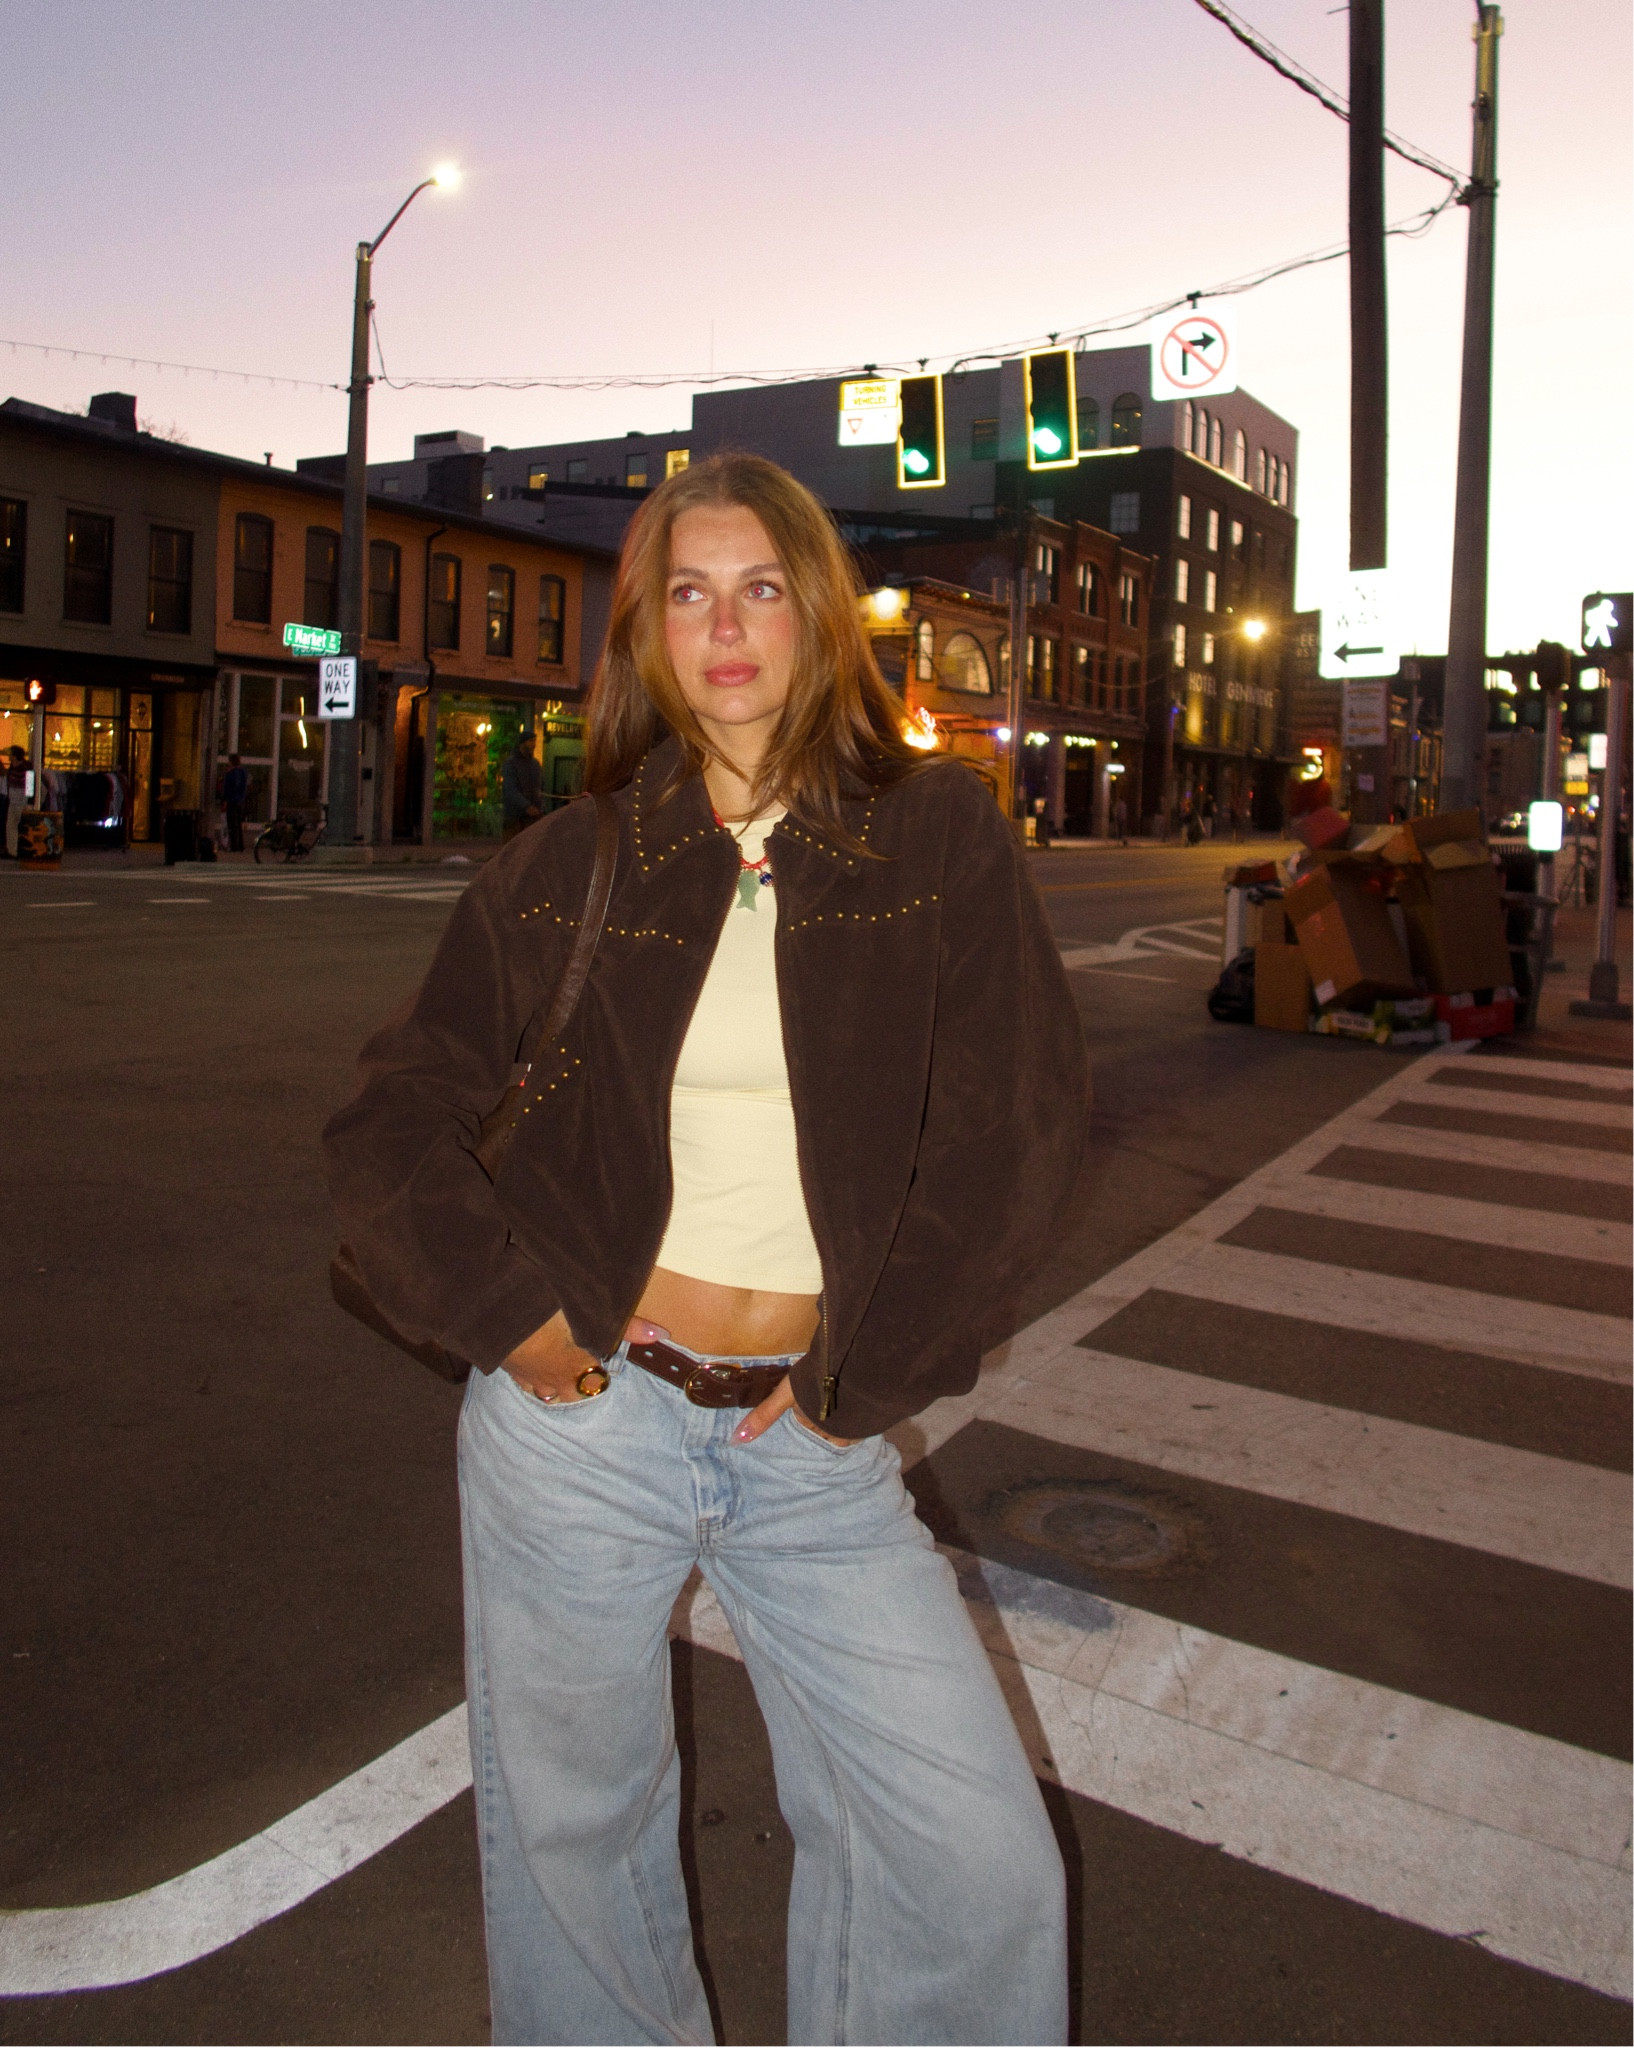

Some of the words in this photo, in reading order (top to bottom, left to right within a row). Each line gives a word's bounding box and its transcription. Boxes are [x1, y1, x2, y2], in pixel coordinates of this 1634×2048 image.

[854, 385, 887, 394] TURNING
[853, 396, 887, 405] VEHICLES
[287, 628, 294, 641] E
[295, 628, 327, 648] Market
[326, 663, 350, 678] ONE
[325, 680, 350, 695] WAY
[1188, 671, 1216, 695] HOTEL
[547, 722, 580, 733] REVELRY
